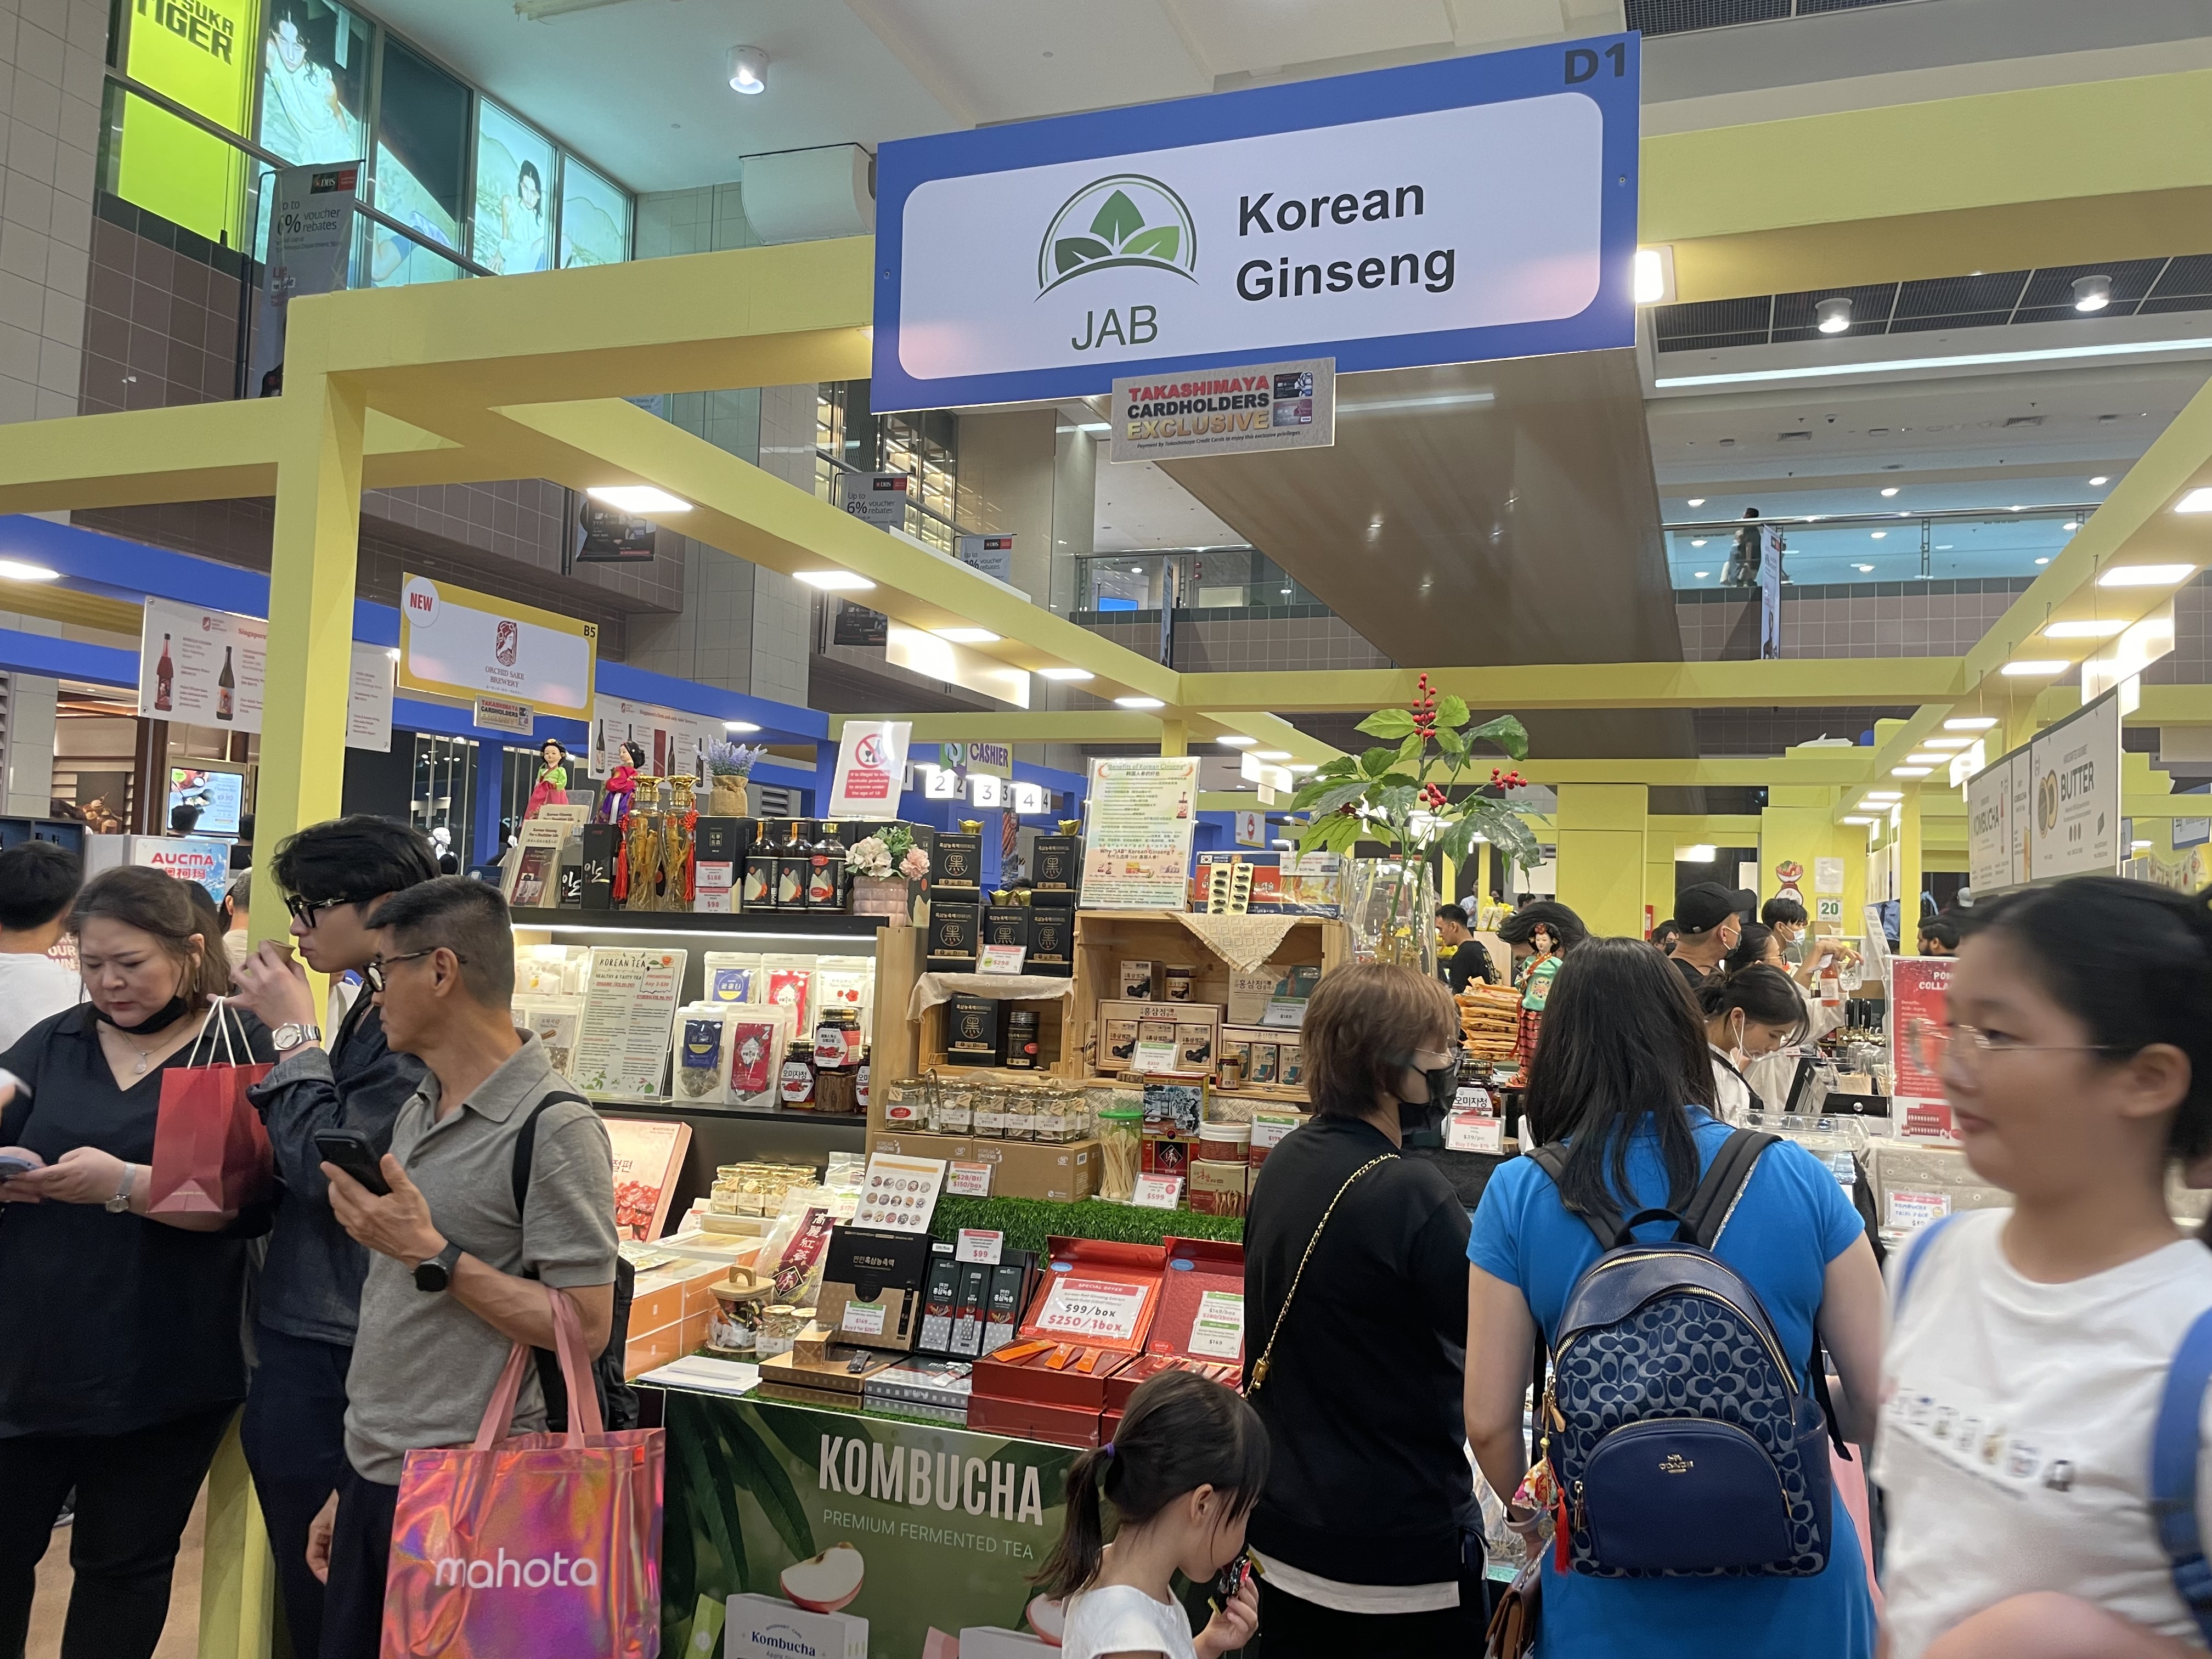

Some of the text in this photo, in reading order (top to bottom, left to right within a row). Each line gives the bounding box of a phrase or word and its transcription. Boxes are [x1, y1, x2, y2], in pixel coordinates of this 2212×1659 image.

[1564, 42, 1626, 85] D1
[303, 208, 341, 221] voucher
[1239, 183, 1425, 236] Korean
[303, 221, 337, 233] rebates
[1236, 247, 1456, 301] Ginseng
[1071, 305, 1159, 351] JAB
[1128, 375, 1269, 402] TAKASHIMAYA
[1127, 393, 1269, 419] CARDHOLDERS
[1127, 410, 1269, 441] EXCLUSIVE
[848, 492, 856, 500] Up
[847, 501, 867, 514] 6%
[410, 592, 432, 612] NEW
[583, 624, 596, 638] B5
[485, 666, 524, 680] ORCHID SAKE
[490, 676, 519, 687] BREWERY
[969, 742, 1009, 768] CASHIER
[935, 775, 963, 793] 2 2
[2061, 761, 2094, 802] BUTTER
[983, 785, 1008, 801] 3 3
[1023, 794, 1048, 808] 4 4
[151, 852, 214, 866] AUCMA
[1821, 902, 1839, 915] 20
[599, 958, 646, 968] KOREAN TEA
[1239, 979, 1262, 989] 홍삼정
[1144, 1007, 1166, 1016] 홍삼정
[782, 1070, 807, 1079] 오미자청
[1454, 1096, 1487, 1108] 오미자청
[1147, 1192, 1165, 1200] $599
[973, 1249, 988, 1257] $99
[1065, 1304, 1116, 1317] $99/box
[1048, 1314, 1122, 1331] $250/3box
[819, 1434, 1043, 1526] KOMBUCHA
[823, 1509, 1034, 1560] PREMIUM FERMENTED TEA
[435, 1547, 597, 1588] mahota
[752, 1631, 815, 1657] Kombucha
